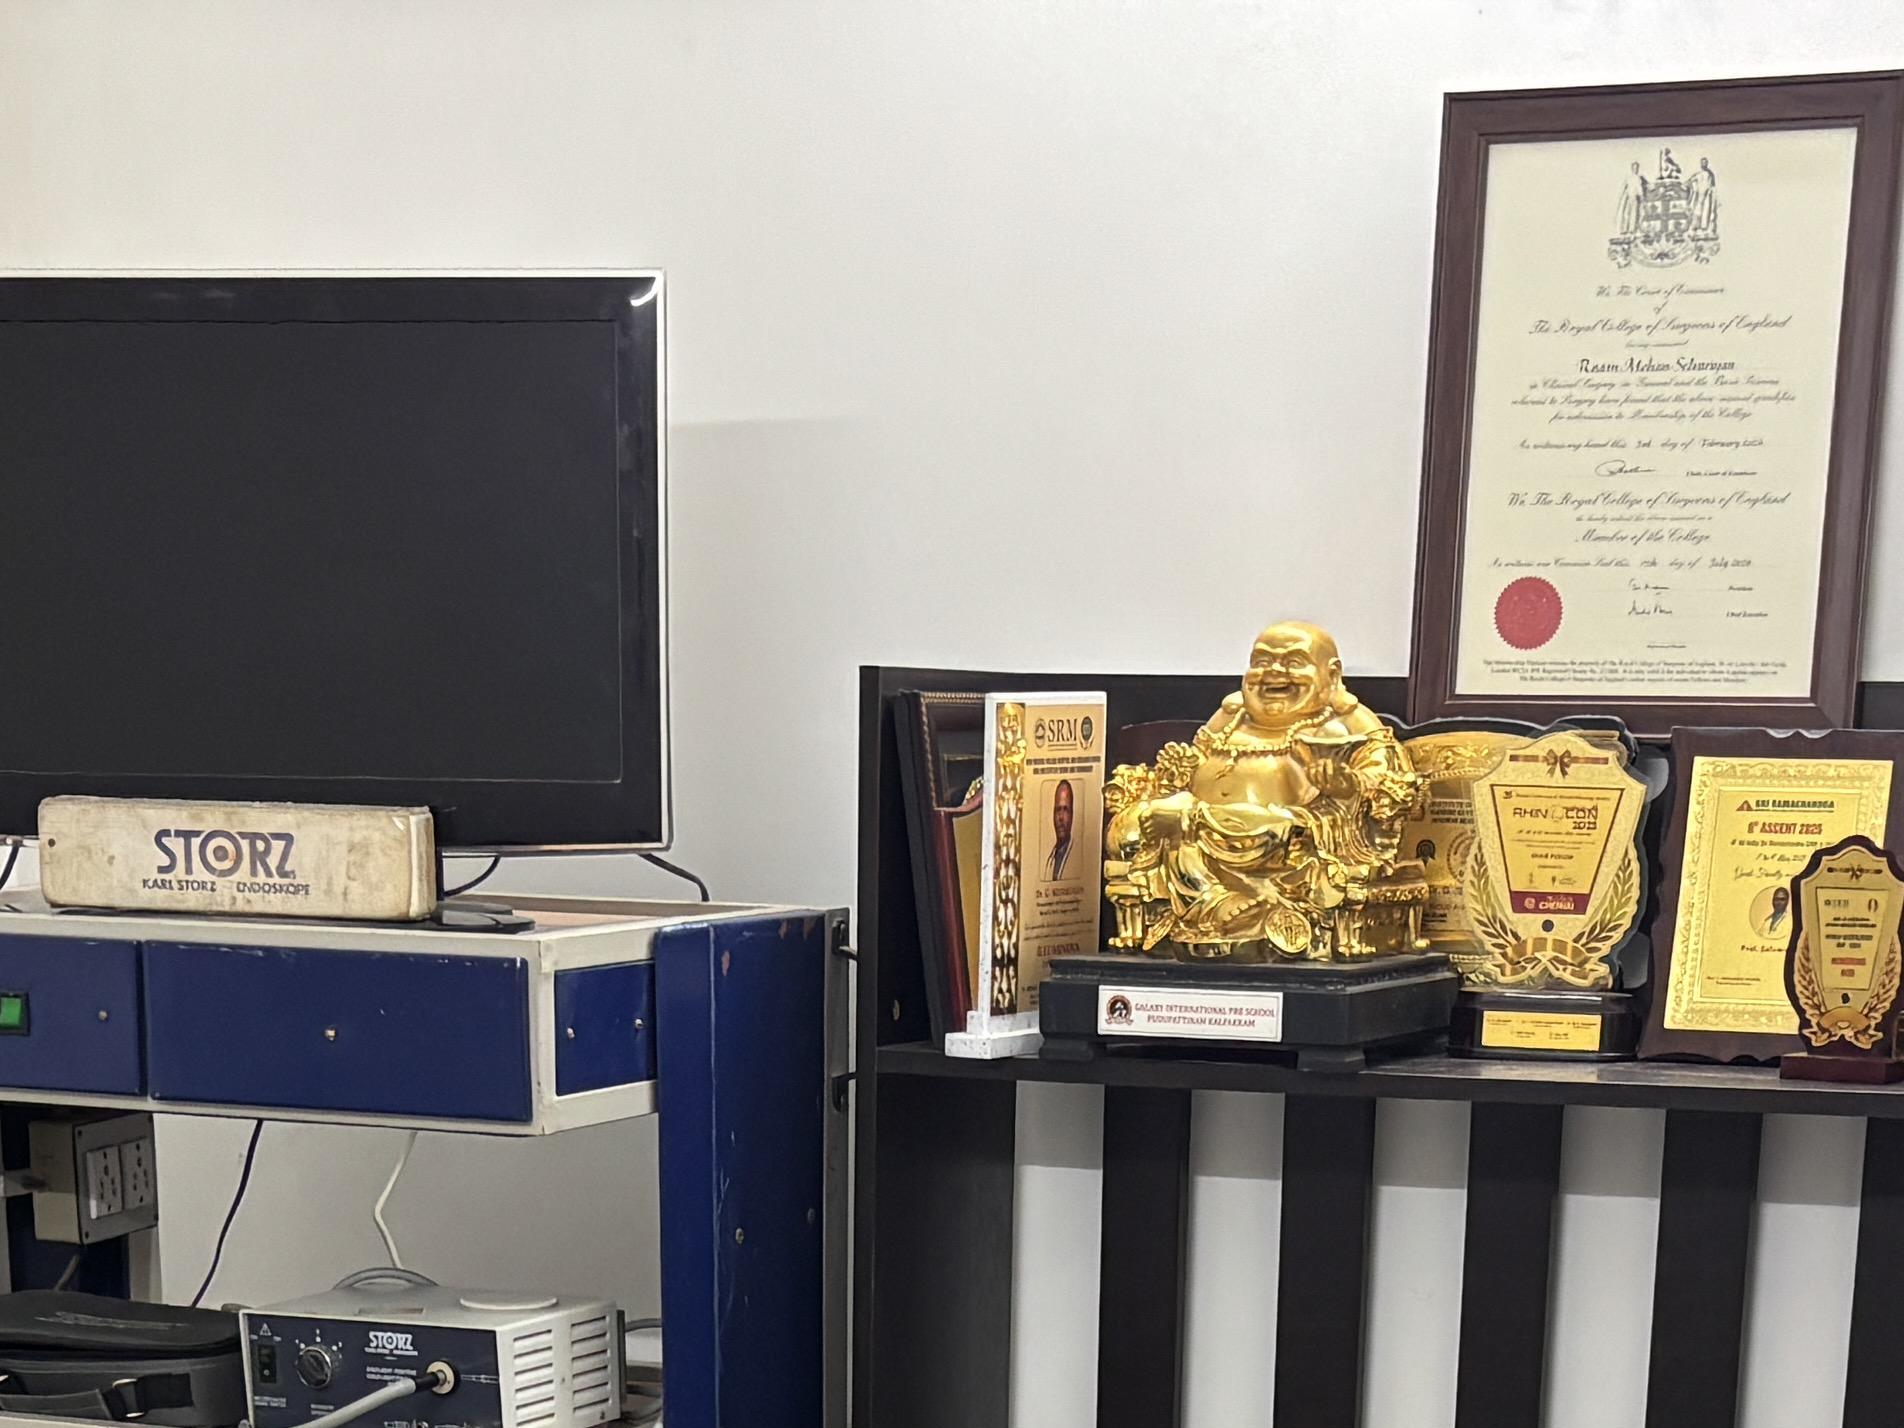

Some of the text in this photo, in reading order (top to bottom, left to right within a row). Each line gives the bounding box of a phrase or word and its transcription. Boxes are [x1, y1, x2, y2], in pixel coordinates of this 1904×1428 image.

[1047, 718, 1078, 744] SRM
[153, 828, 297, 880] STORZ
[142, 877, 175, 890] KARL
[177, 879, 218, 893] STORZ
